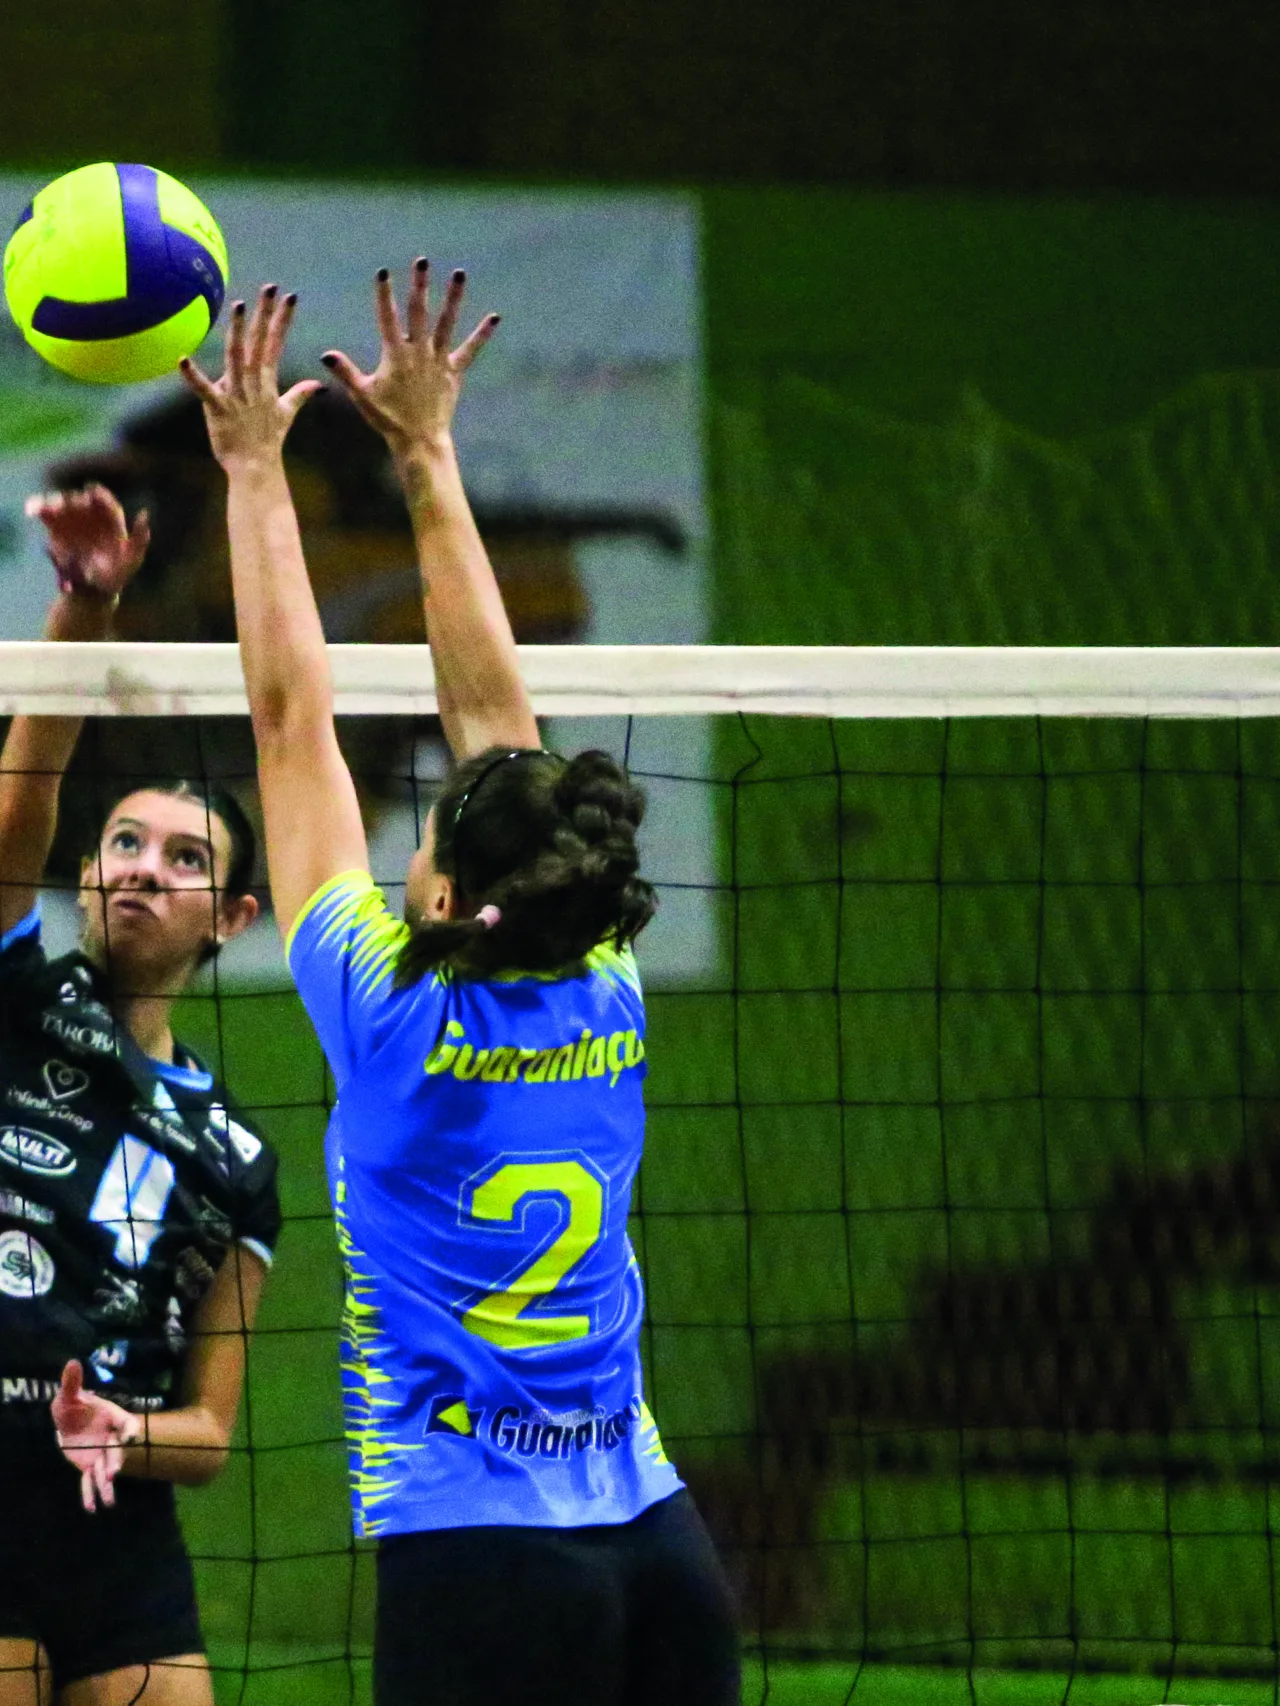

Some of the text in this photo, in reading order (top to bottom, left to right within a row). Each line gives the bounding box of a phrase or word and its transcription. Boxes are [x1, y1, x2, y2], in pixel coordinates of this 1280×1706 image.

[424, 1019, 646, 1088] Guaraniaçu
[1, 1130, 66, 1166] MULTI
[460, 1159, 605, 1351] 2
